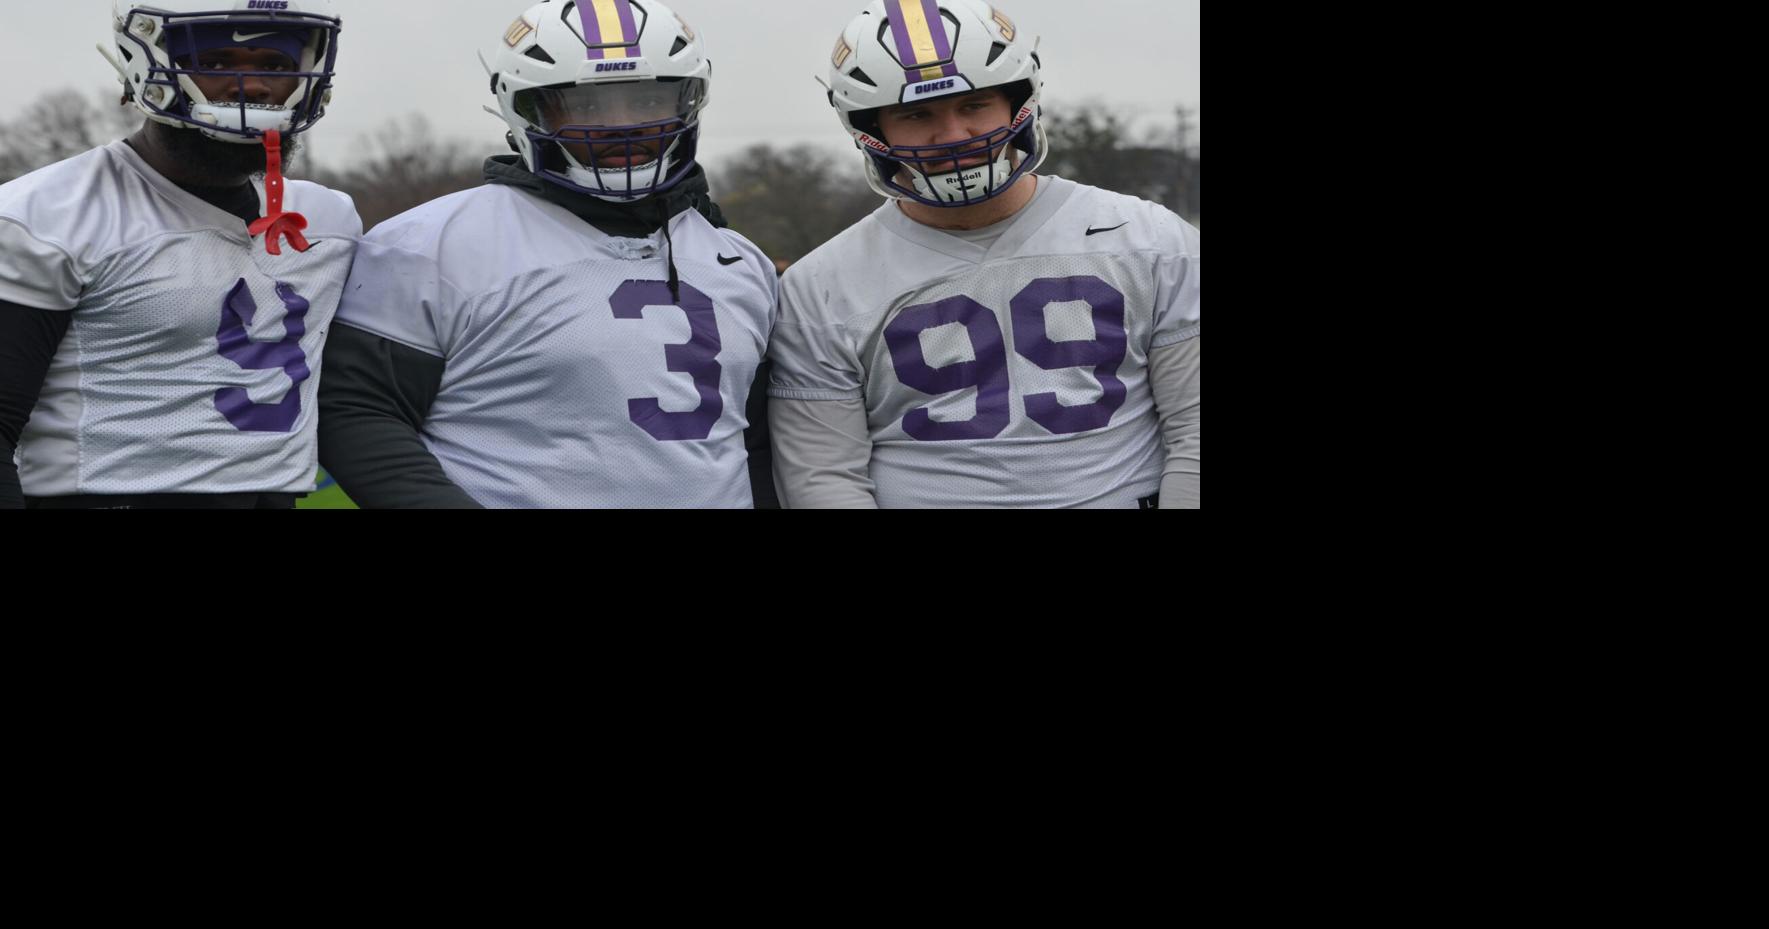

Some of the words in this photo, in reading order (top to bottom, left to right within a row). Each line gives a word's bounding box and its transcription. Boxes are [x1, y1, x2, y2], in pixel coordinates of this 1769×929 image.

[248, 0, 288, 9] DUKES
[595, 62, 636, 72] DUKES
[915, 79, 954, 94] DUKES
[214, 278, 311, 432] 9
[609, 279, 723, 441] 3
[884, 275, 1127, 441] 99
